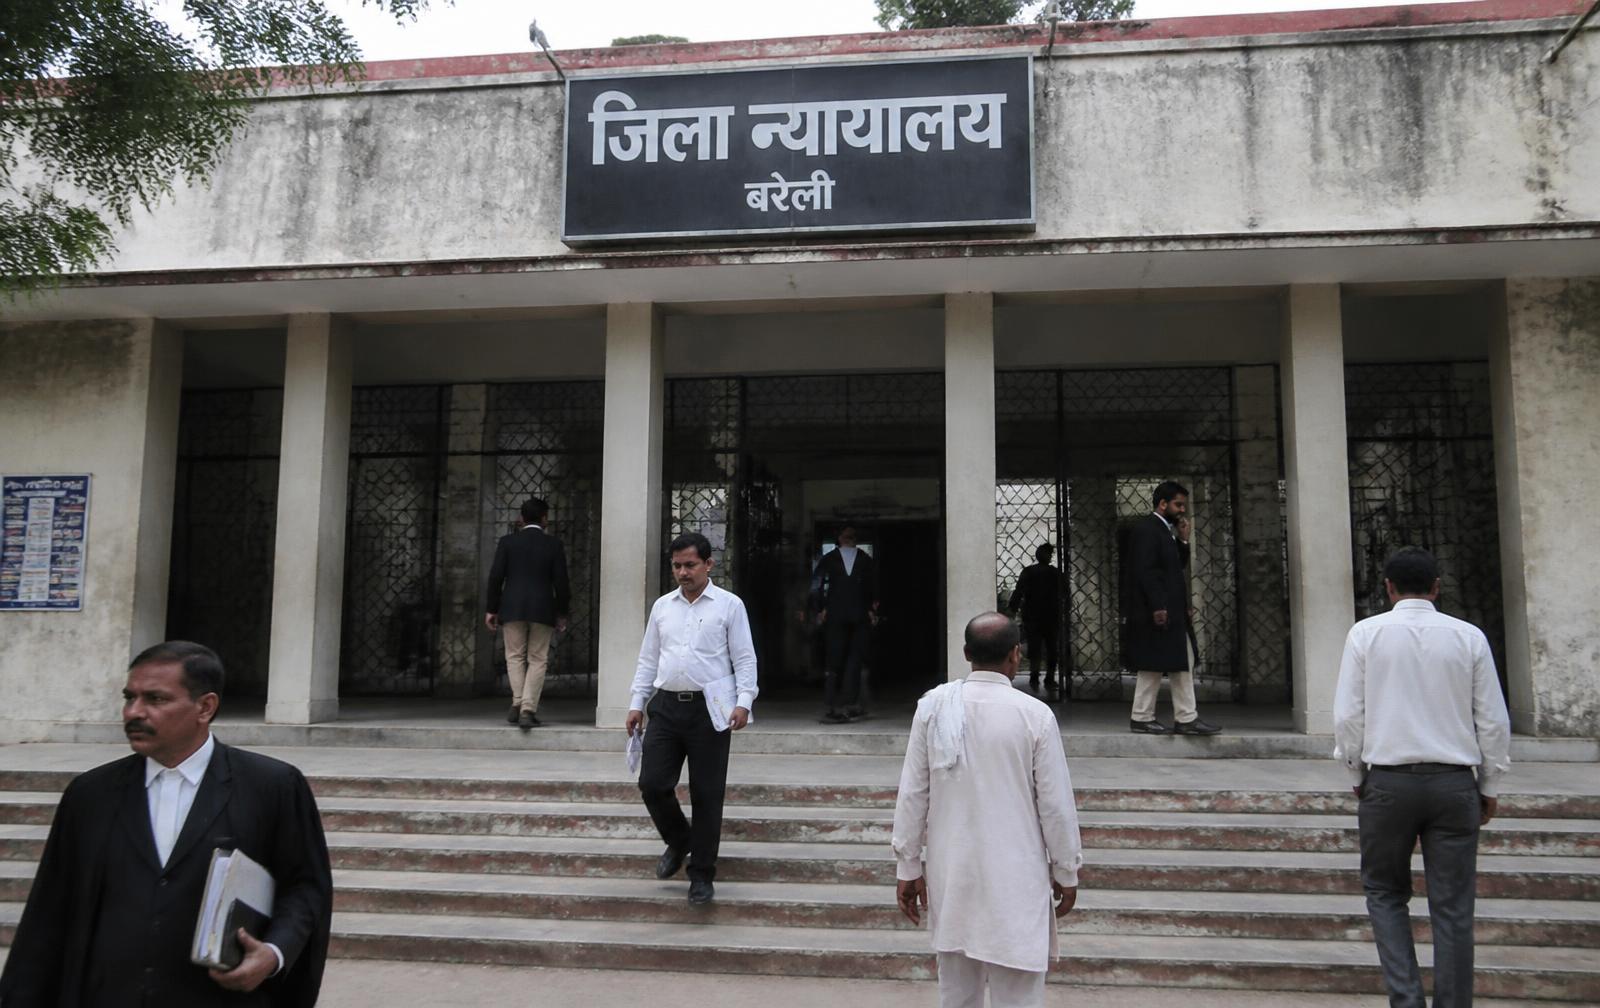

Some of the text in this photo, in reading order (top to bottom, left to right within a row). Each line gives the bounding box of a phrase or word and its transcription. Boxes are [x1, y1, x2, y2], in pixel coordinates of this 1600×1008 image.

[587, 90, 1007, 165] जिला न्यायालय
[744, 169, 836, 212] बरेली
